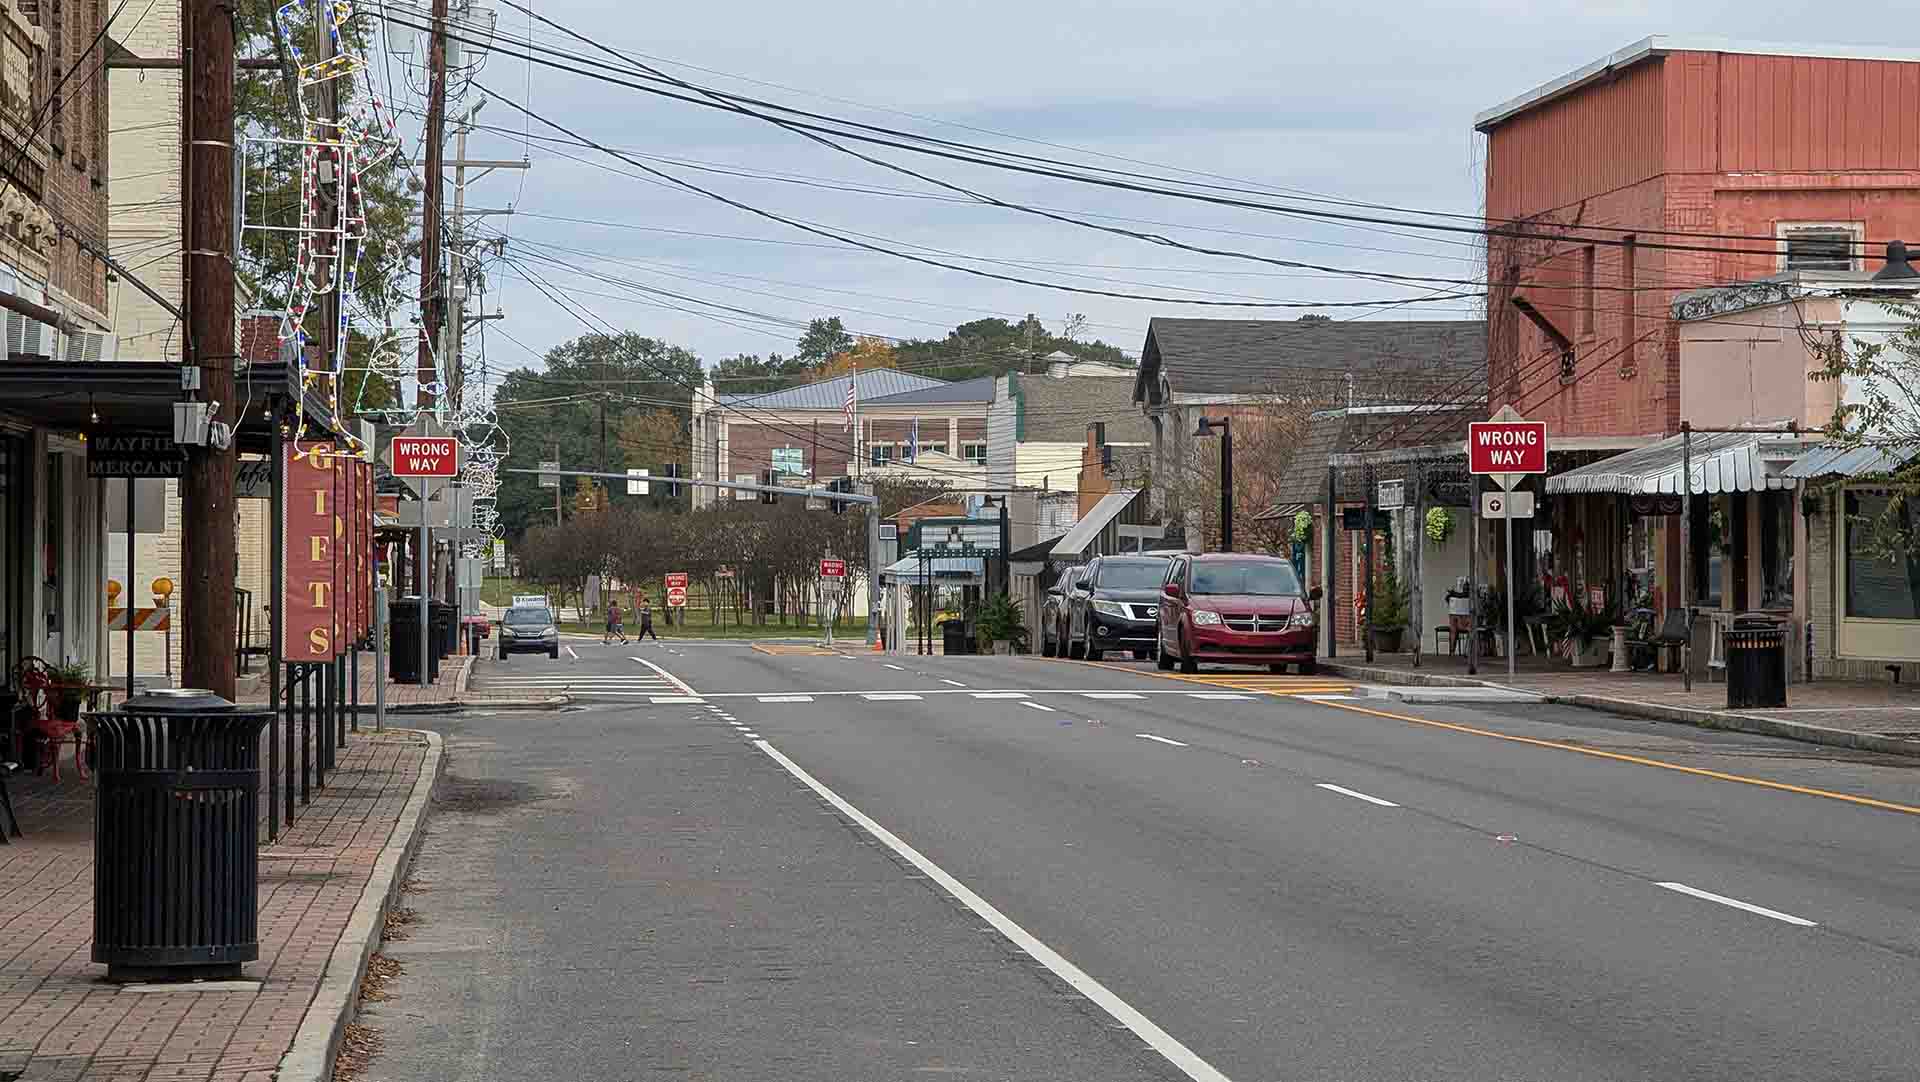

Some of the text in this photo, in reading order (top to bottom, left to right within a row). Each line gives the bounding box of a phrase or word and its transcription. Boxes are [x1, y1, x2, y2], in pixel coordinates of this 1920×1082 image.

[1479, 430, 1537, 446] WRONG
[400, 442, 450, 456] WRONG
[409, 457, 440, 472] WAY
[1490, 450, 1526, 465] WAY
[308, 443, 332, 655] GIFTS
